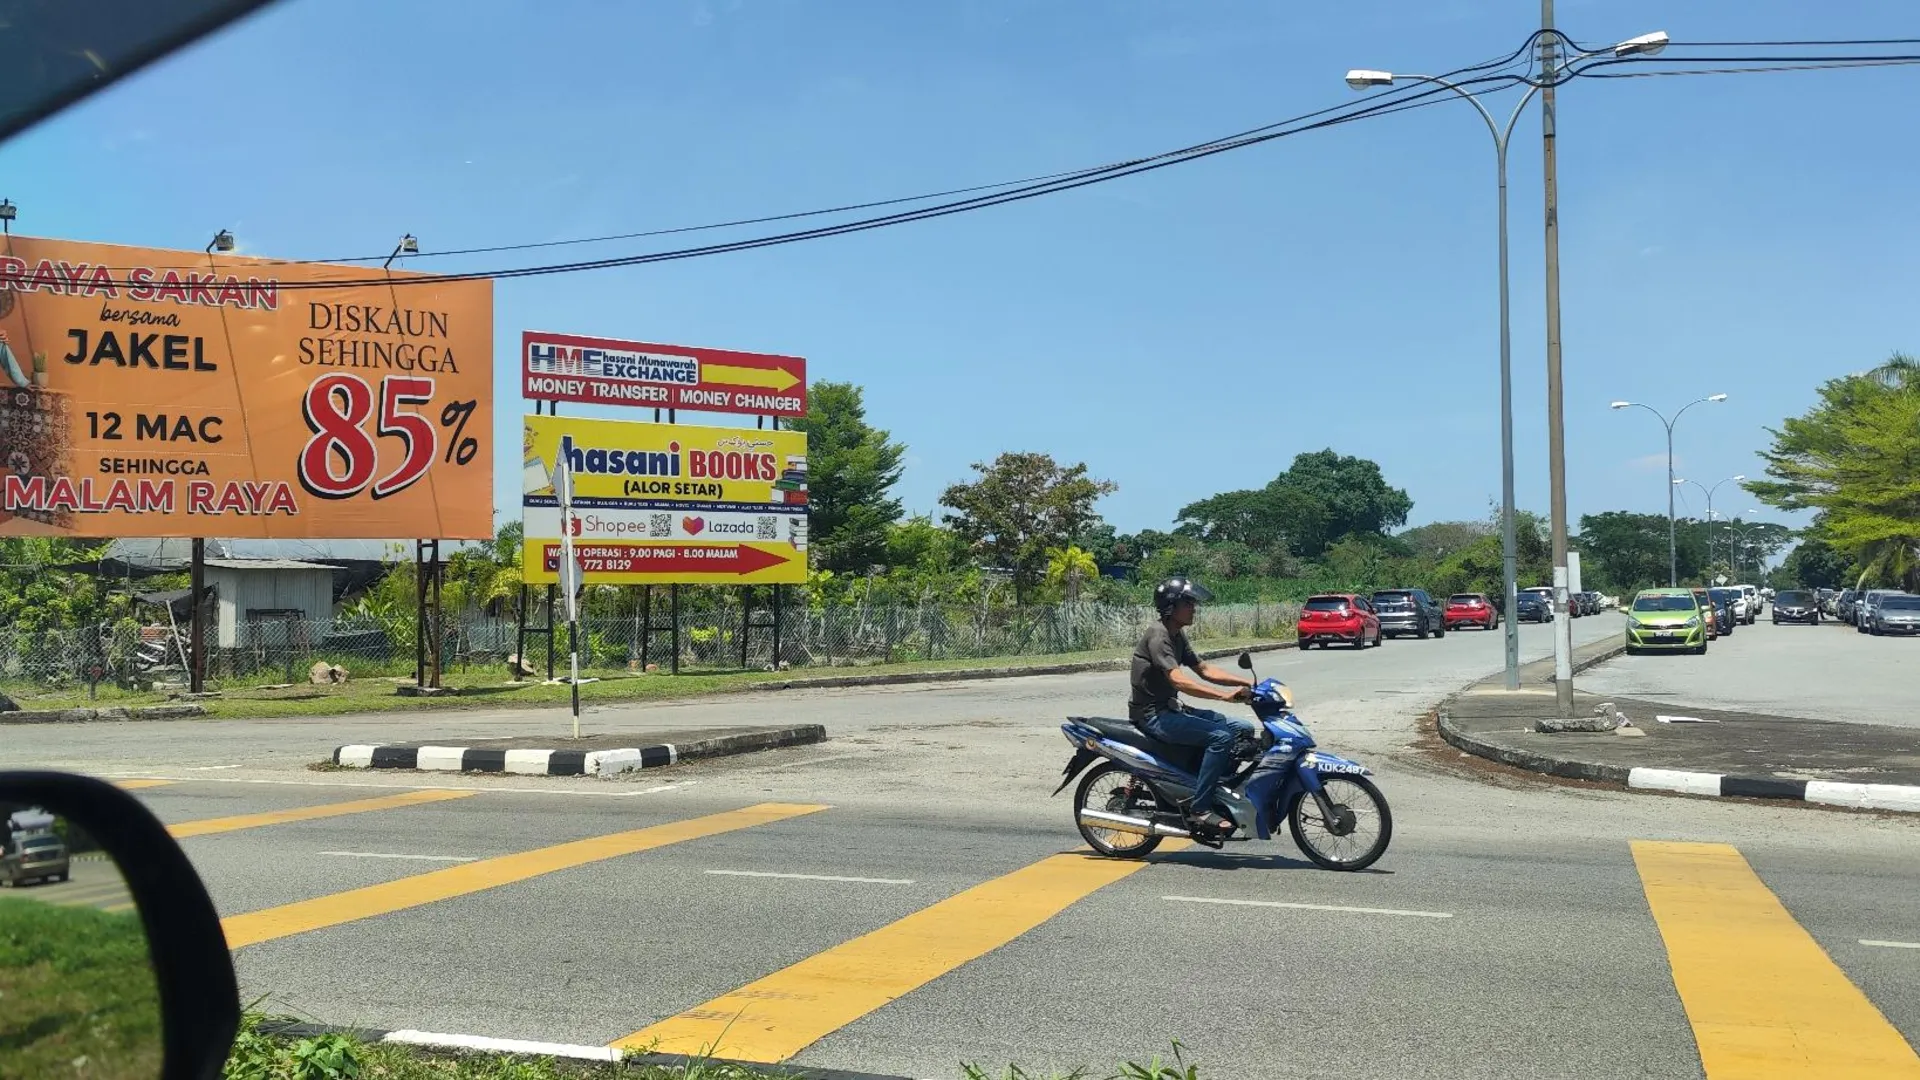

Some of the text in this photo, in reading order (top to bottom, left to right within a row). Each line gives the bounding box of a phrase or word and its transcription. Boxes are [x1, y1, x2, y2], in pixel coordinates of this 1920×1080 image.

[0, 255, 279, 311] RAYA SAKAN
[99, 301, 181, 328] bersama
[308, 302, 448, 339] DISKAUN
[64, 328, 218, 372] JAKEL
[298, 337, 460, 374] SEHINGGA
[530, 343, 603, 376] HME
[603, 353, 697, 371] hasani Munawarah
[603, 363, 697, 384] EXCHANGE
[528, 376, 585, 397] MONEY
[590, 381, 669, 403] TRANSFER
[680, 389, 731, 406] MONEY
[735, 393, 801, 412] CHANGER
[85, 411, 224, 444] 12 MAC
[99, 456, 211, 477] SEHINGGA
[563, 435, 778, 482] hasani BOOKS
[4, 473, 299, 516] MALAM RAYA
[585, 514, 647, 536] Shopee
[708, 520, 754, 535] Lazada
[583, 547, 622, 558] OPERASI
[630, 548, 651, 558] 9.00
[653, 549, 676, 558] PAGI
[706, 549, 738, 560] MALAM
[584, 559, 632, 570] 772 8129
